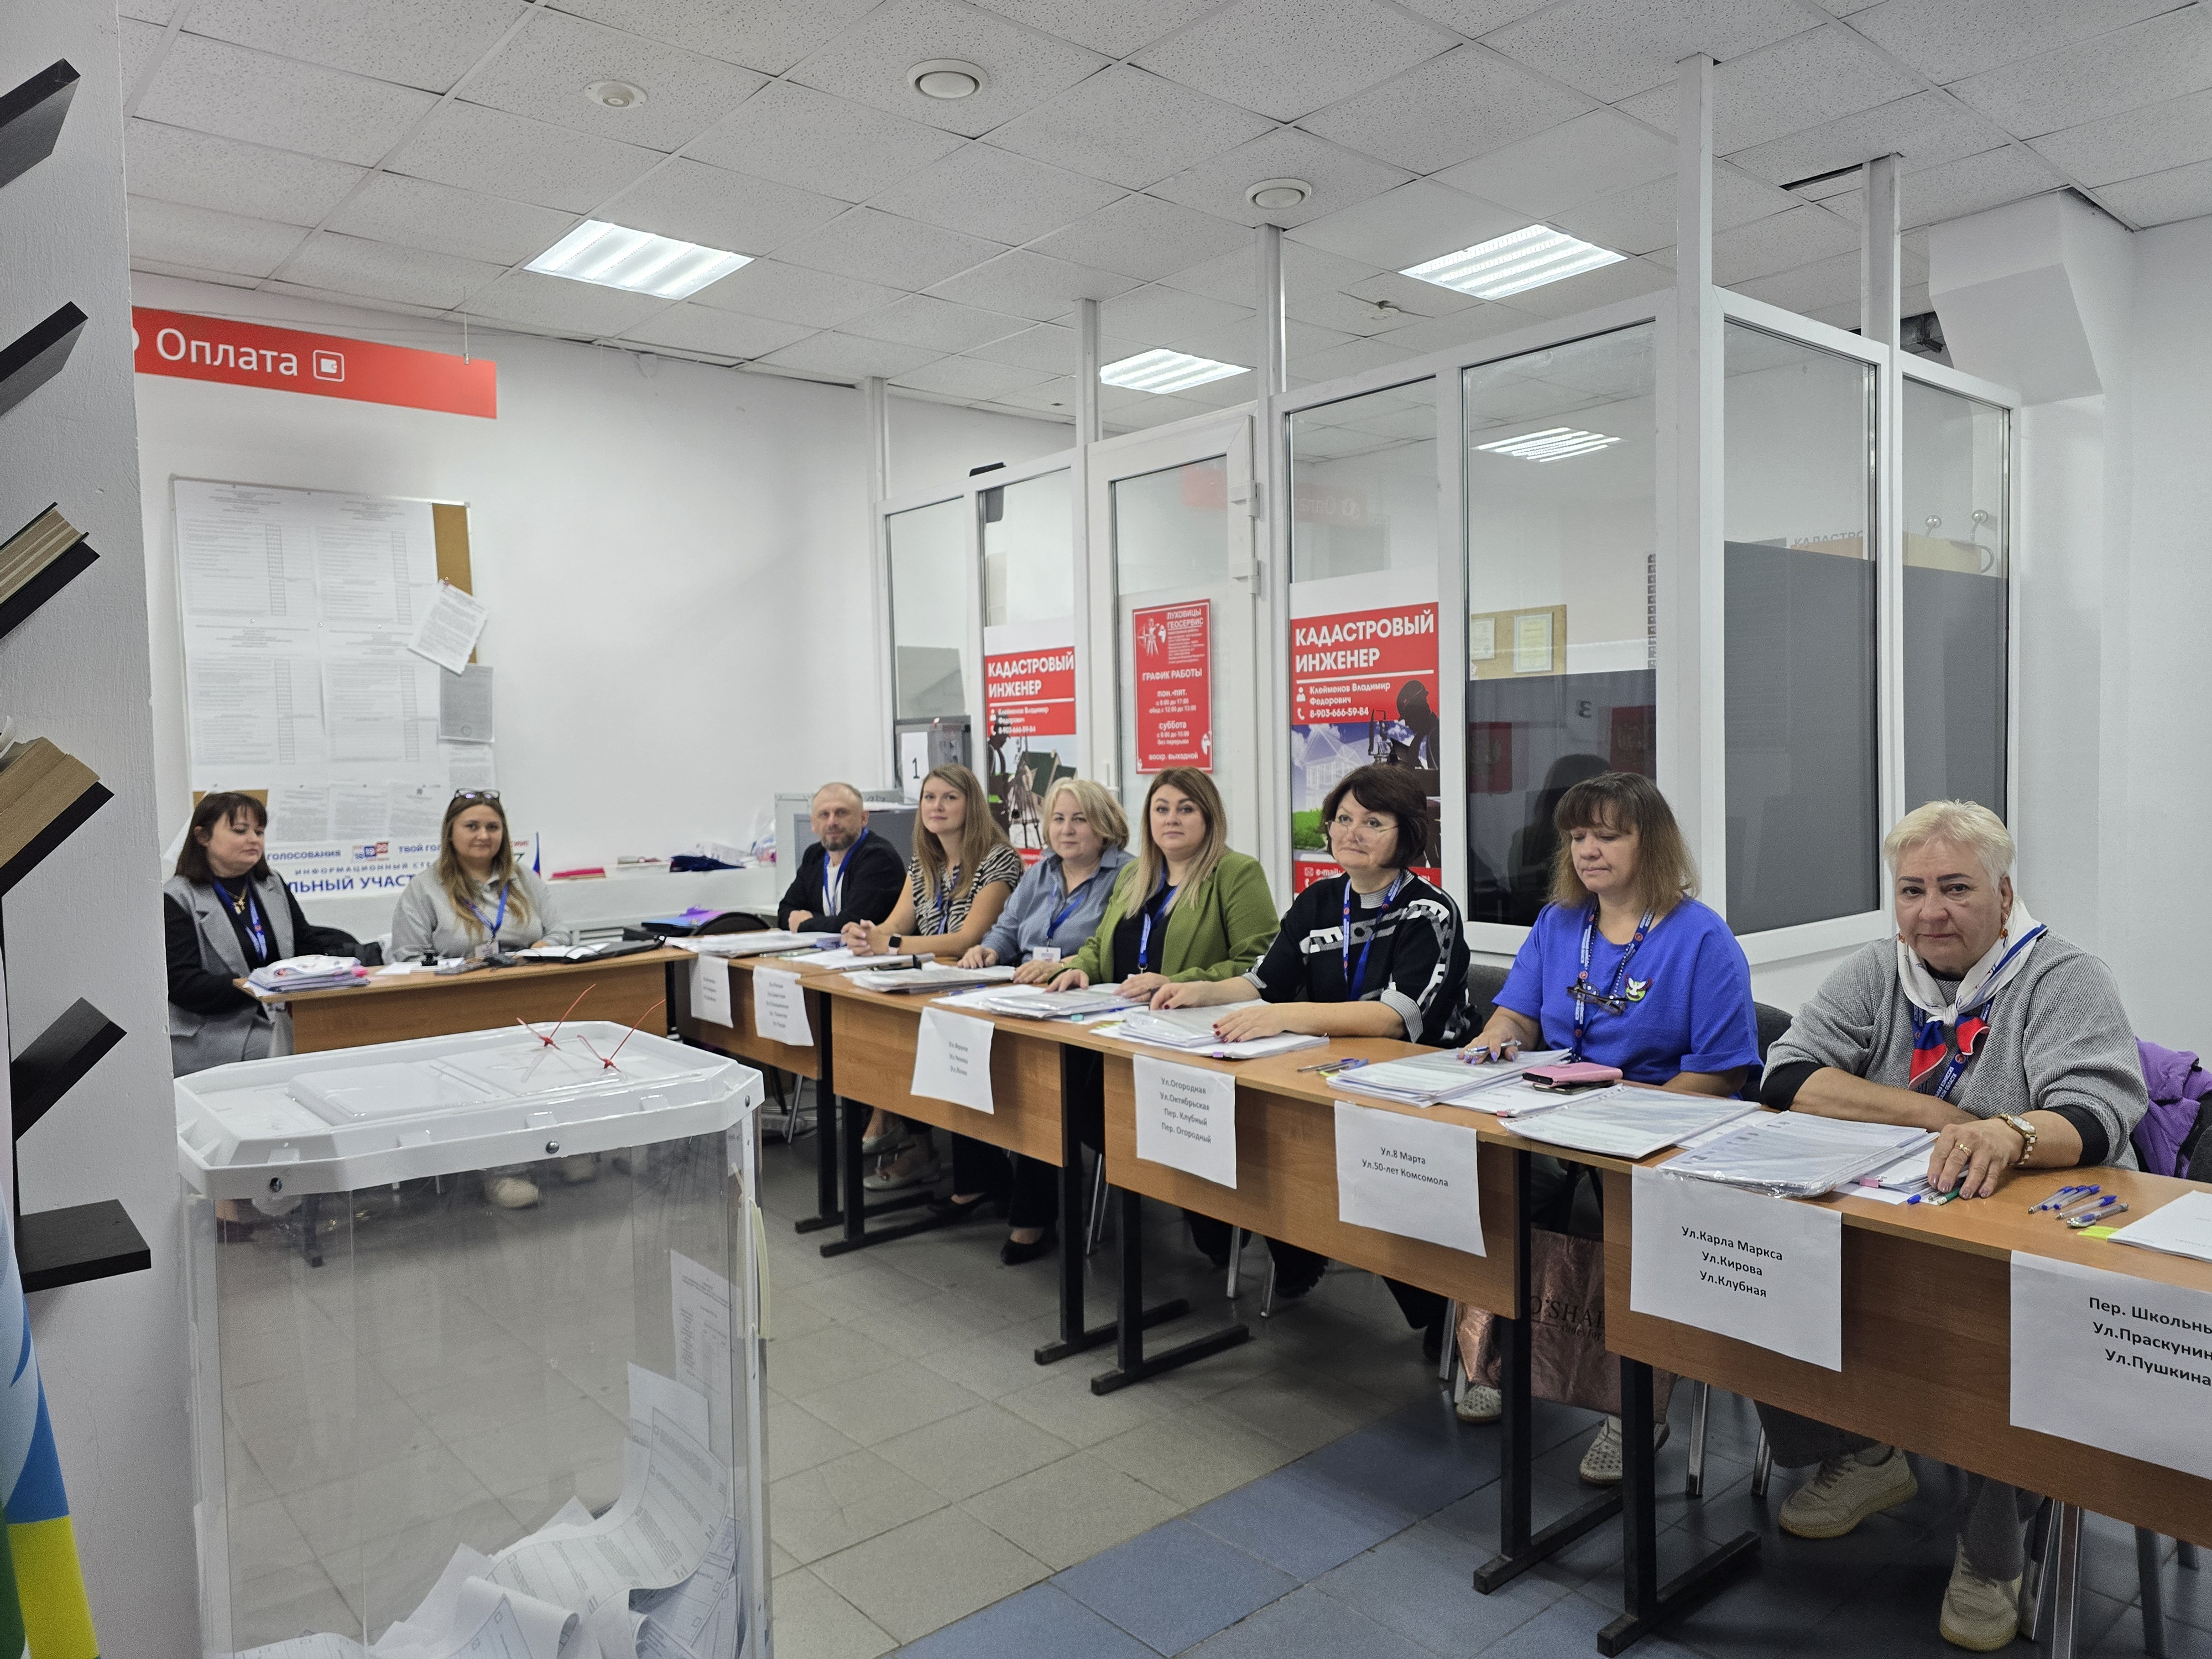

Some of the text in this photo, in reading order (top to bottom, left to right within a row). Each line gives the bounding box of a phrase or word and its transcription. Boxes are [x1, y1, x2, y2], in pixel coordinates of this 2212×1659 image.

[156, 328, 298, 377] Оплата
[1167, 608, 1202, 620] ЛУХОВИЦЫ
[1167, 617, 1204, 629] ГЕОСЕРВИС
[1296, 609, 1434, 647] КАДАСТРОВЫЙ
[988, 651, 1074, 678] КАДАСТРОВЫЙ
[1296, 648, 1380, 673] ИНЖЕНЕР
[1142, 668, 1202, 681] ГРАФИК РАБОТЫ
[988, 680, 1042, 698] ИНЖЕНЕР
[1352, 682, 1391, 692] Владимир
[1310, 697, 1352, 707] Федорович
[1310, 707, 1369, 718] 8-903-666-59-84
[1159, 721, 1187, 731] суббота
[912, 757, 920, 779] 1
[288, 873, 416, 893] ЛЬНЫЙ УЧАСТ
[1161, 1077, 1207, 1094] Ул.Огородная
[1164, 1108, 1208, 1126] Пер. Клубный
[1161, 1122, 1212, 1144] Пер. Огородный
[1381, 1147, 1426, 1165] Ул.8 Марта
[1361, 1159, 1449, 1187] Ул.50-лет Комсомола
[1682, 1226, 1783, 1261] Ул.Карла Маркса
[1702, 1251, 1763, 1276] Ул.Кирова
[1699, 1270, 1767, 1297] Ул.Клубная
[2089, 1297, 2126, 1316] Пер.
[2105, 1349, 2211, 1386] Ул.Пушкина
